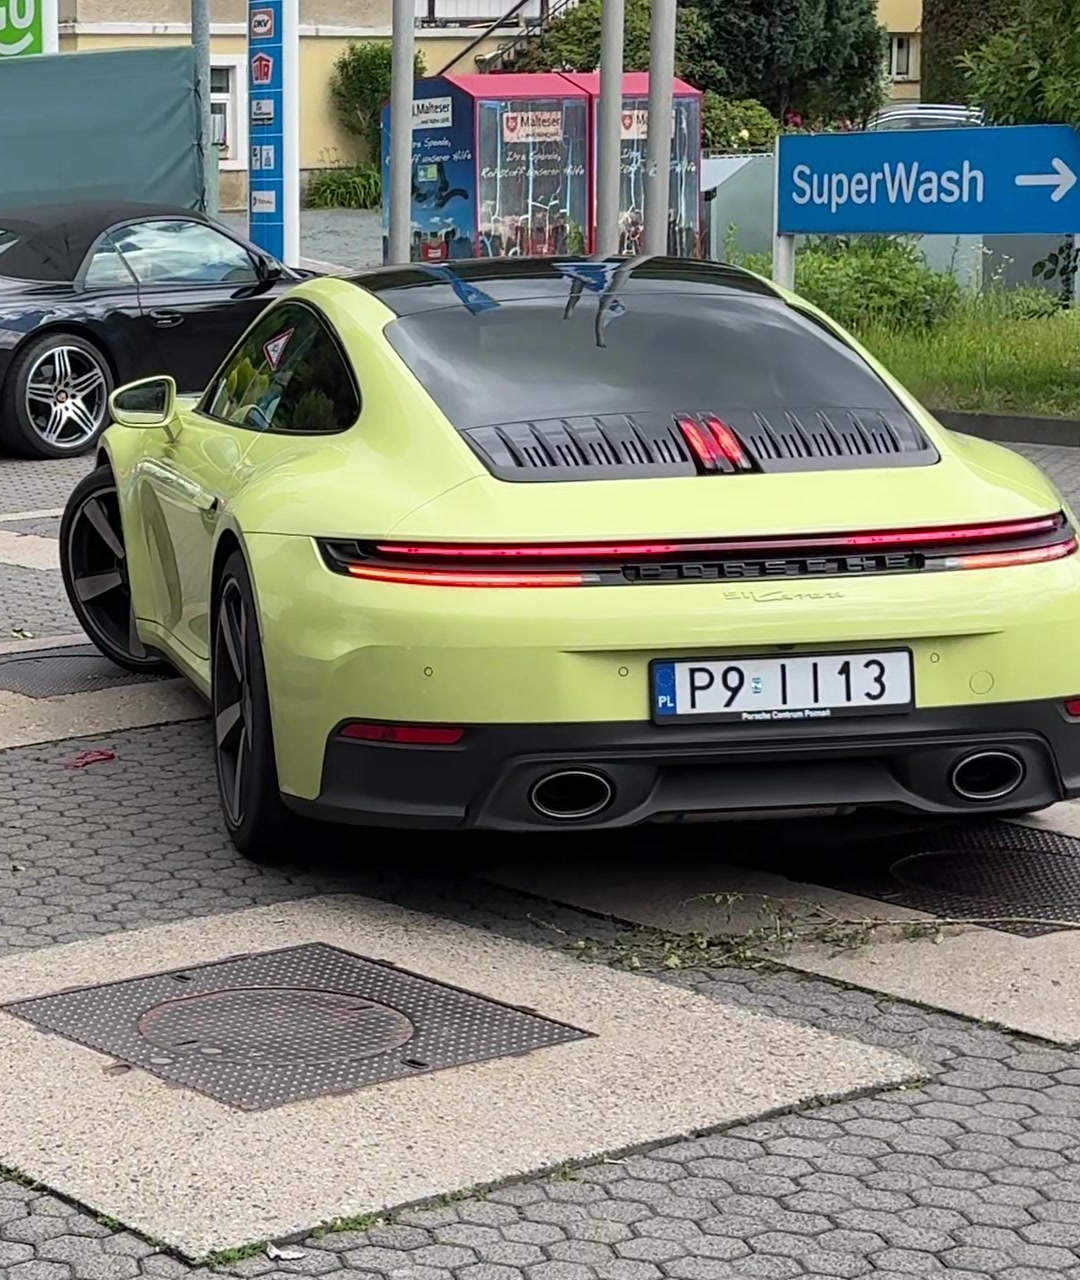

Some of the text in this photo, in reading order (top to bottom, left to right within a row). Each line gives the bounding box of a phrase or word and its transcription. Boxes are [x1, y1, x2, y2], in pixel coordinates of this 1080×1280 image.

[254, 19, 269, 28] DKV
[520, 115, 560, 127] Malteser
[791, 160, 984, 214] SuperWash
[688, 666, 745, 709] P9
[658, 696, 674, 708] PL
